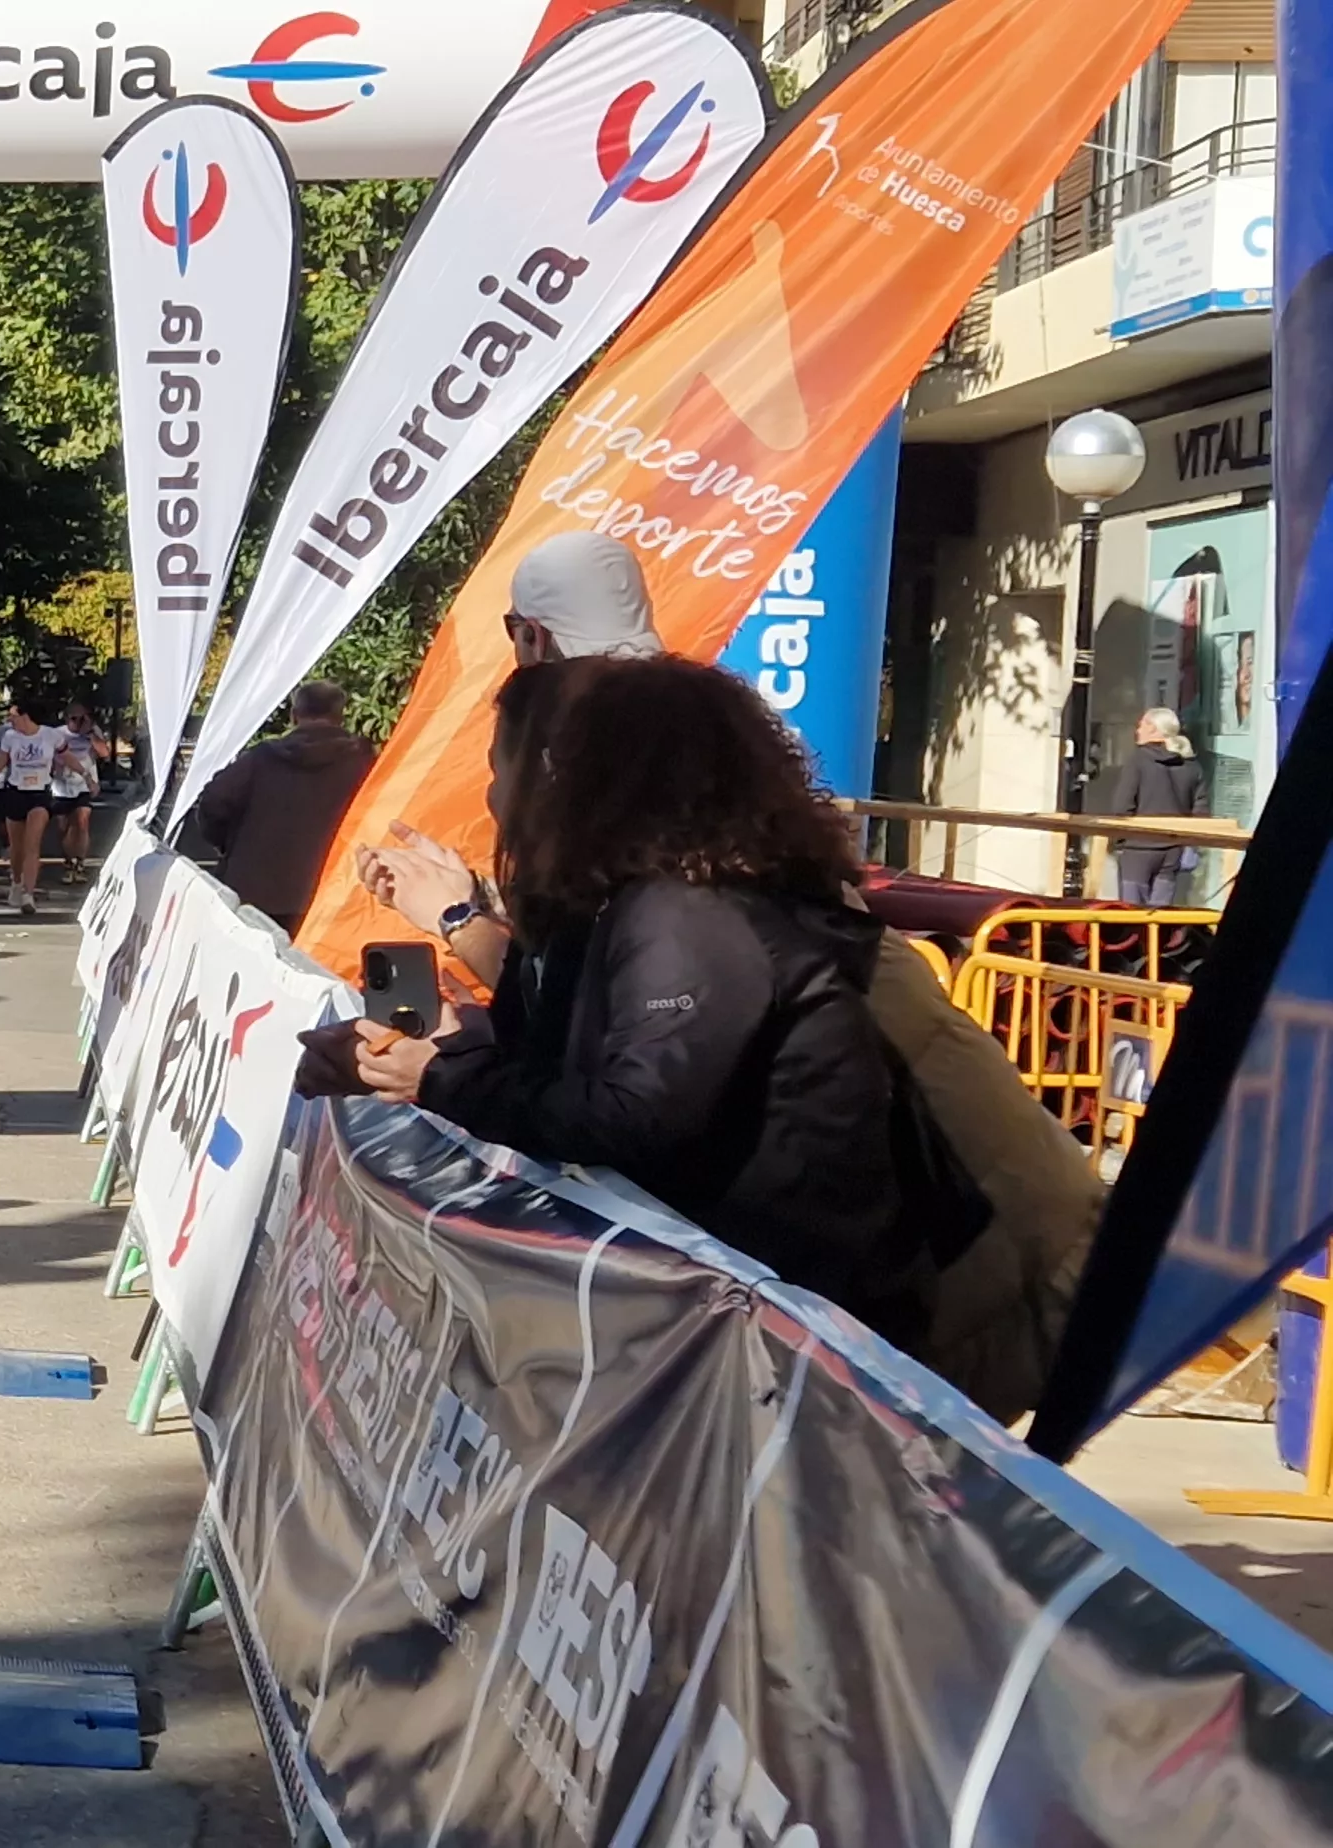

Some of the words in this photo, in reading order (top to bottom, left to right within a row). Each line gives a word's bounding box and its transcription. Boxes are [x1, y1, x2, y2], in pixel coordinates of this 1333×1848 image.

[857, 165, 879, 184] de
[879, 170, 966, 233] Huesca
[873, 135, 1021, 225] Ayuntamiento
[291, 246, 590, 590] Ibercaja
[565, 389, 809, 535] Hacemos
[540, 451, 755, 579] deporte
[747, 548, 826, 712] caja
